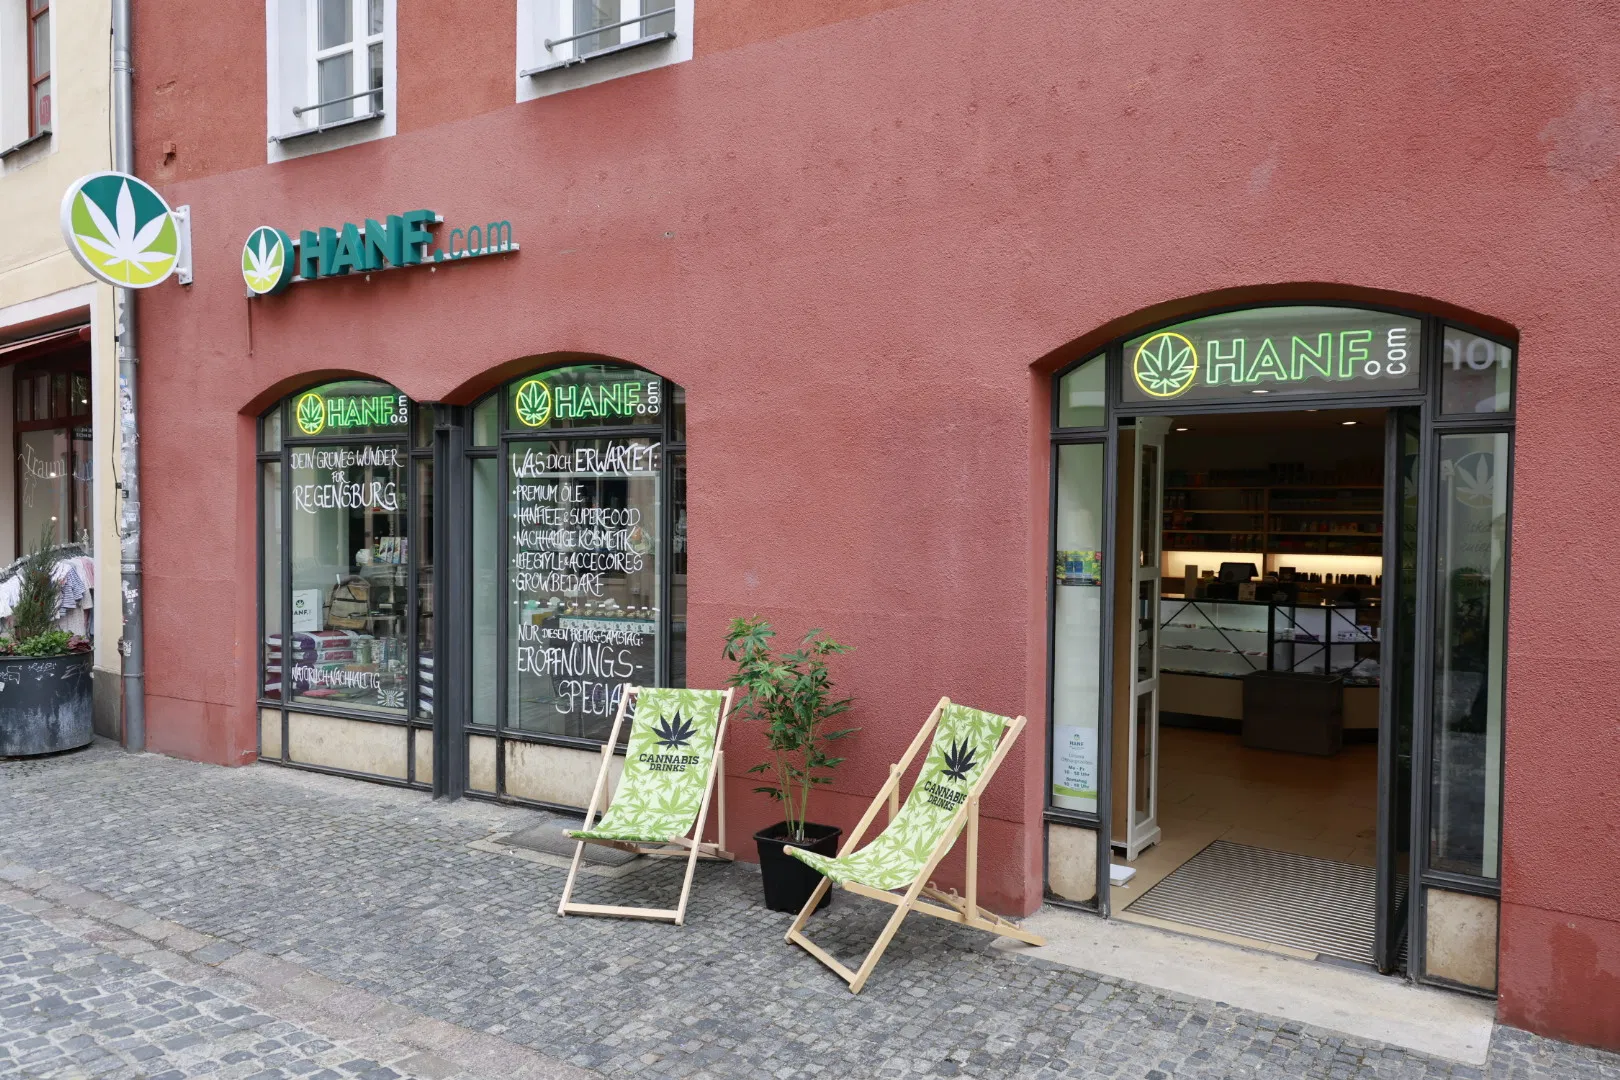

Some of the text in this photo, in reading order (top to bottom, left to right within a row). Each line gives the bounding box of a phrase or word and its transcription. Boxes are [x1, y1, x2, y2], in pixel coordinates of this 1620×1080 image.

[290, 447, 316, 470] DEIN
[355, 445, 405, 467] WUNDER
[512, 447, 545, 479] WAS
[545, 453, 574, 473] DICH
[292, 481, 399, 514] REGENSBURG
[515, 484, 558, 502] PREMIUM
[569, 507, 641, 529] SUPERFOOD
[578, 525, 646, 557] KOSMETIK
[517, 621, 544, 644] NUR
[541, 626, 570, 642] DIESEN
[639, 753, 700, 765] CANNABIS
[649, 763, 686, 772] DRINKS
[927, 794, 955, 811] DRINKS
